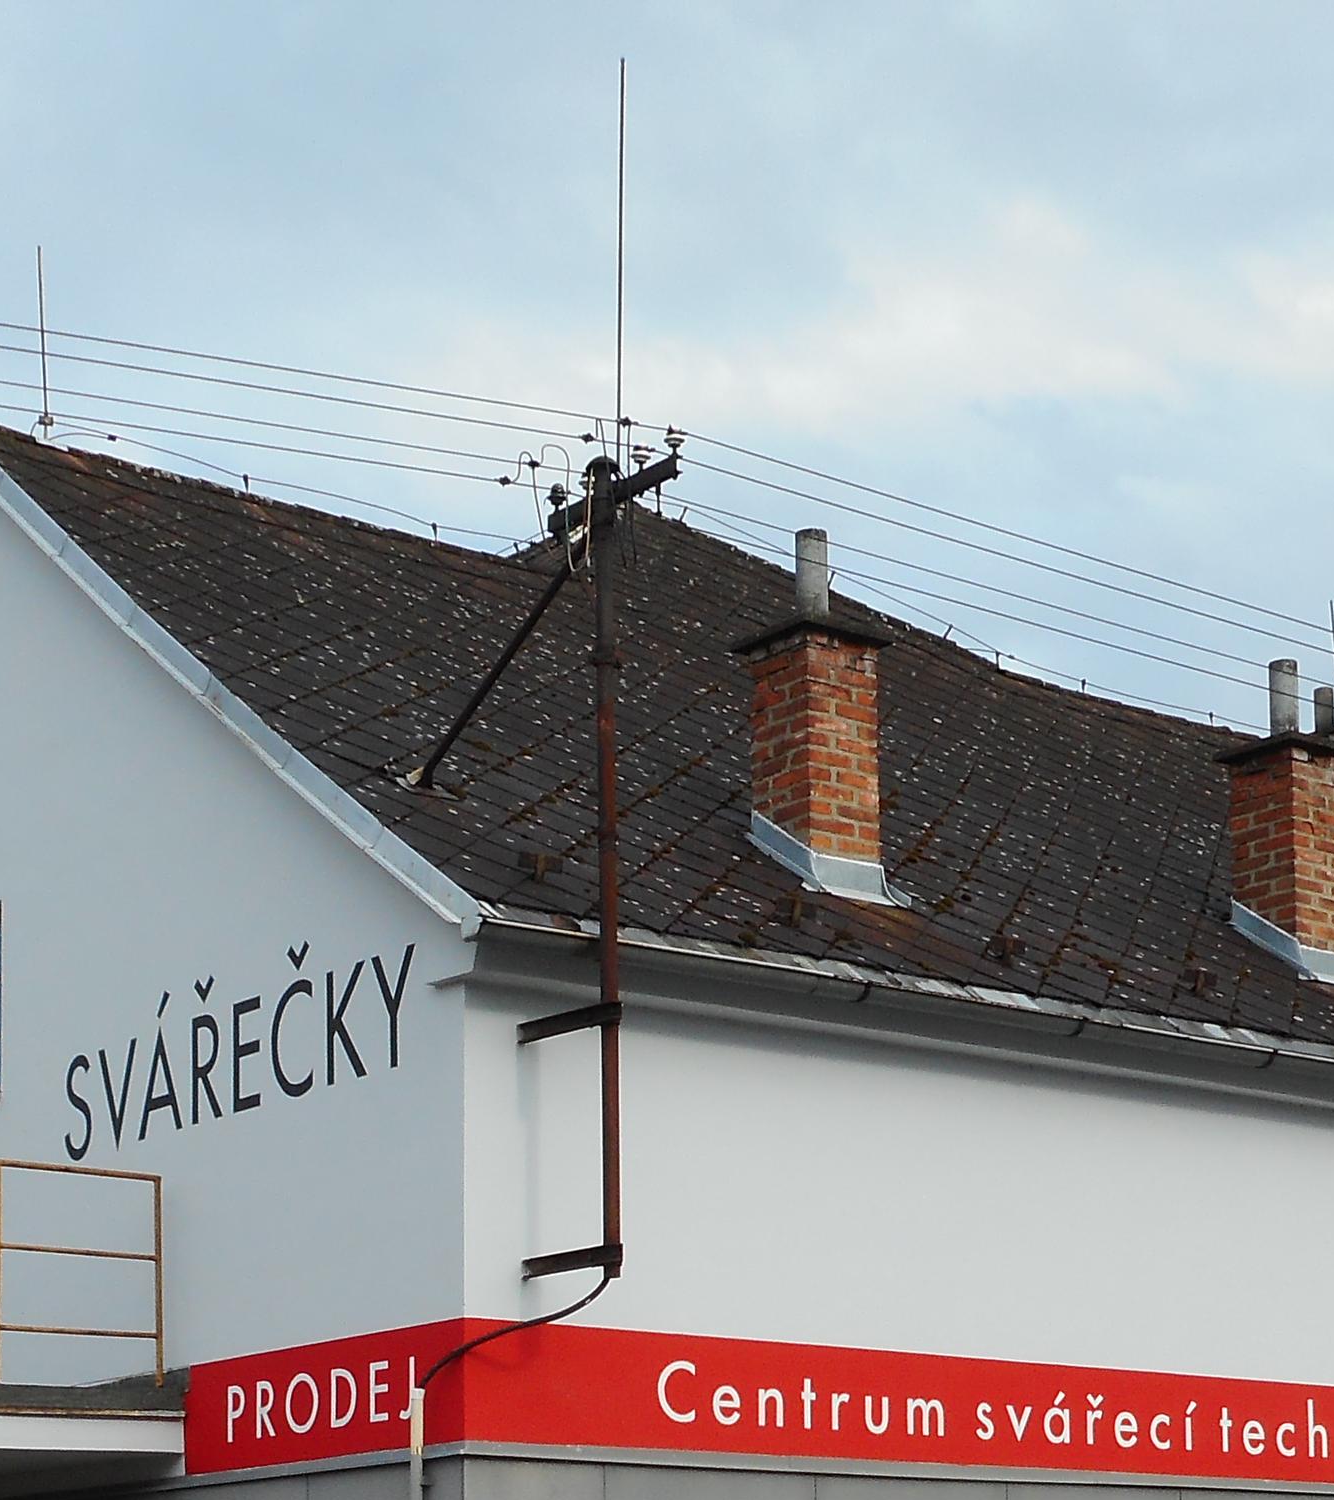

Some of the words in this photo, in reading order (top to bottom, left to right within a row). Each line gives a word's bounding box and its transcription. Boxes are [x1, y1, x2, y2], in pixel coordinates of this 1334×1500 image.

[64, 941, 416, 1161] SVÁŘEČKY
[226, 1355, 415, 1443] PRODEJ
[656, 1360, 946, 1437] Centrum
[975, 1391, 1198, 1452] svářecí
